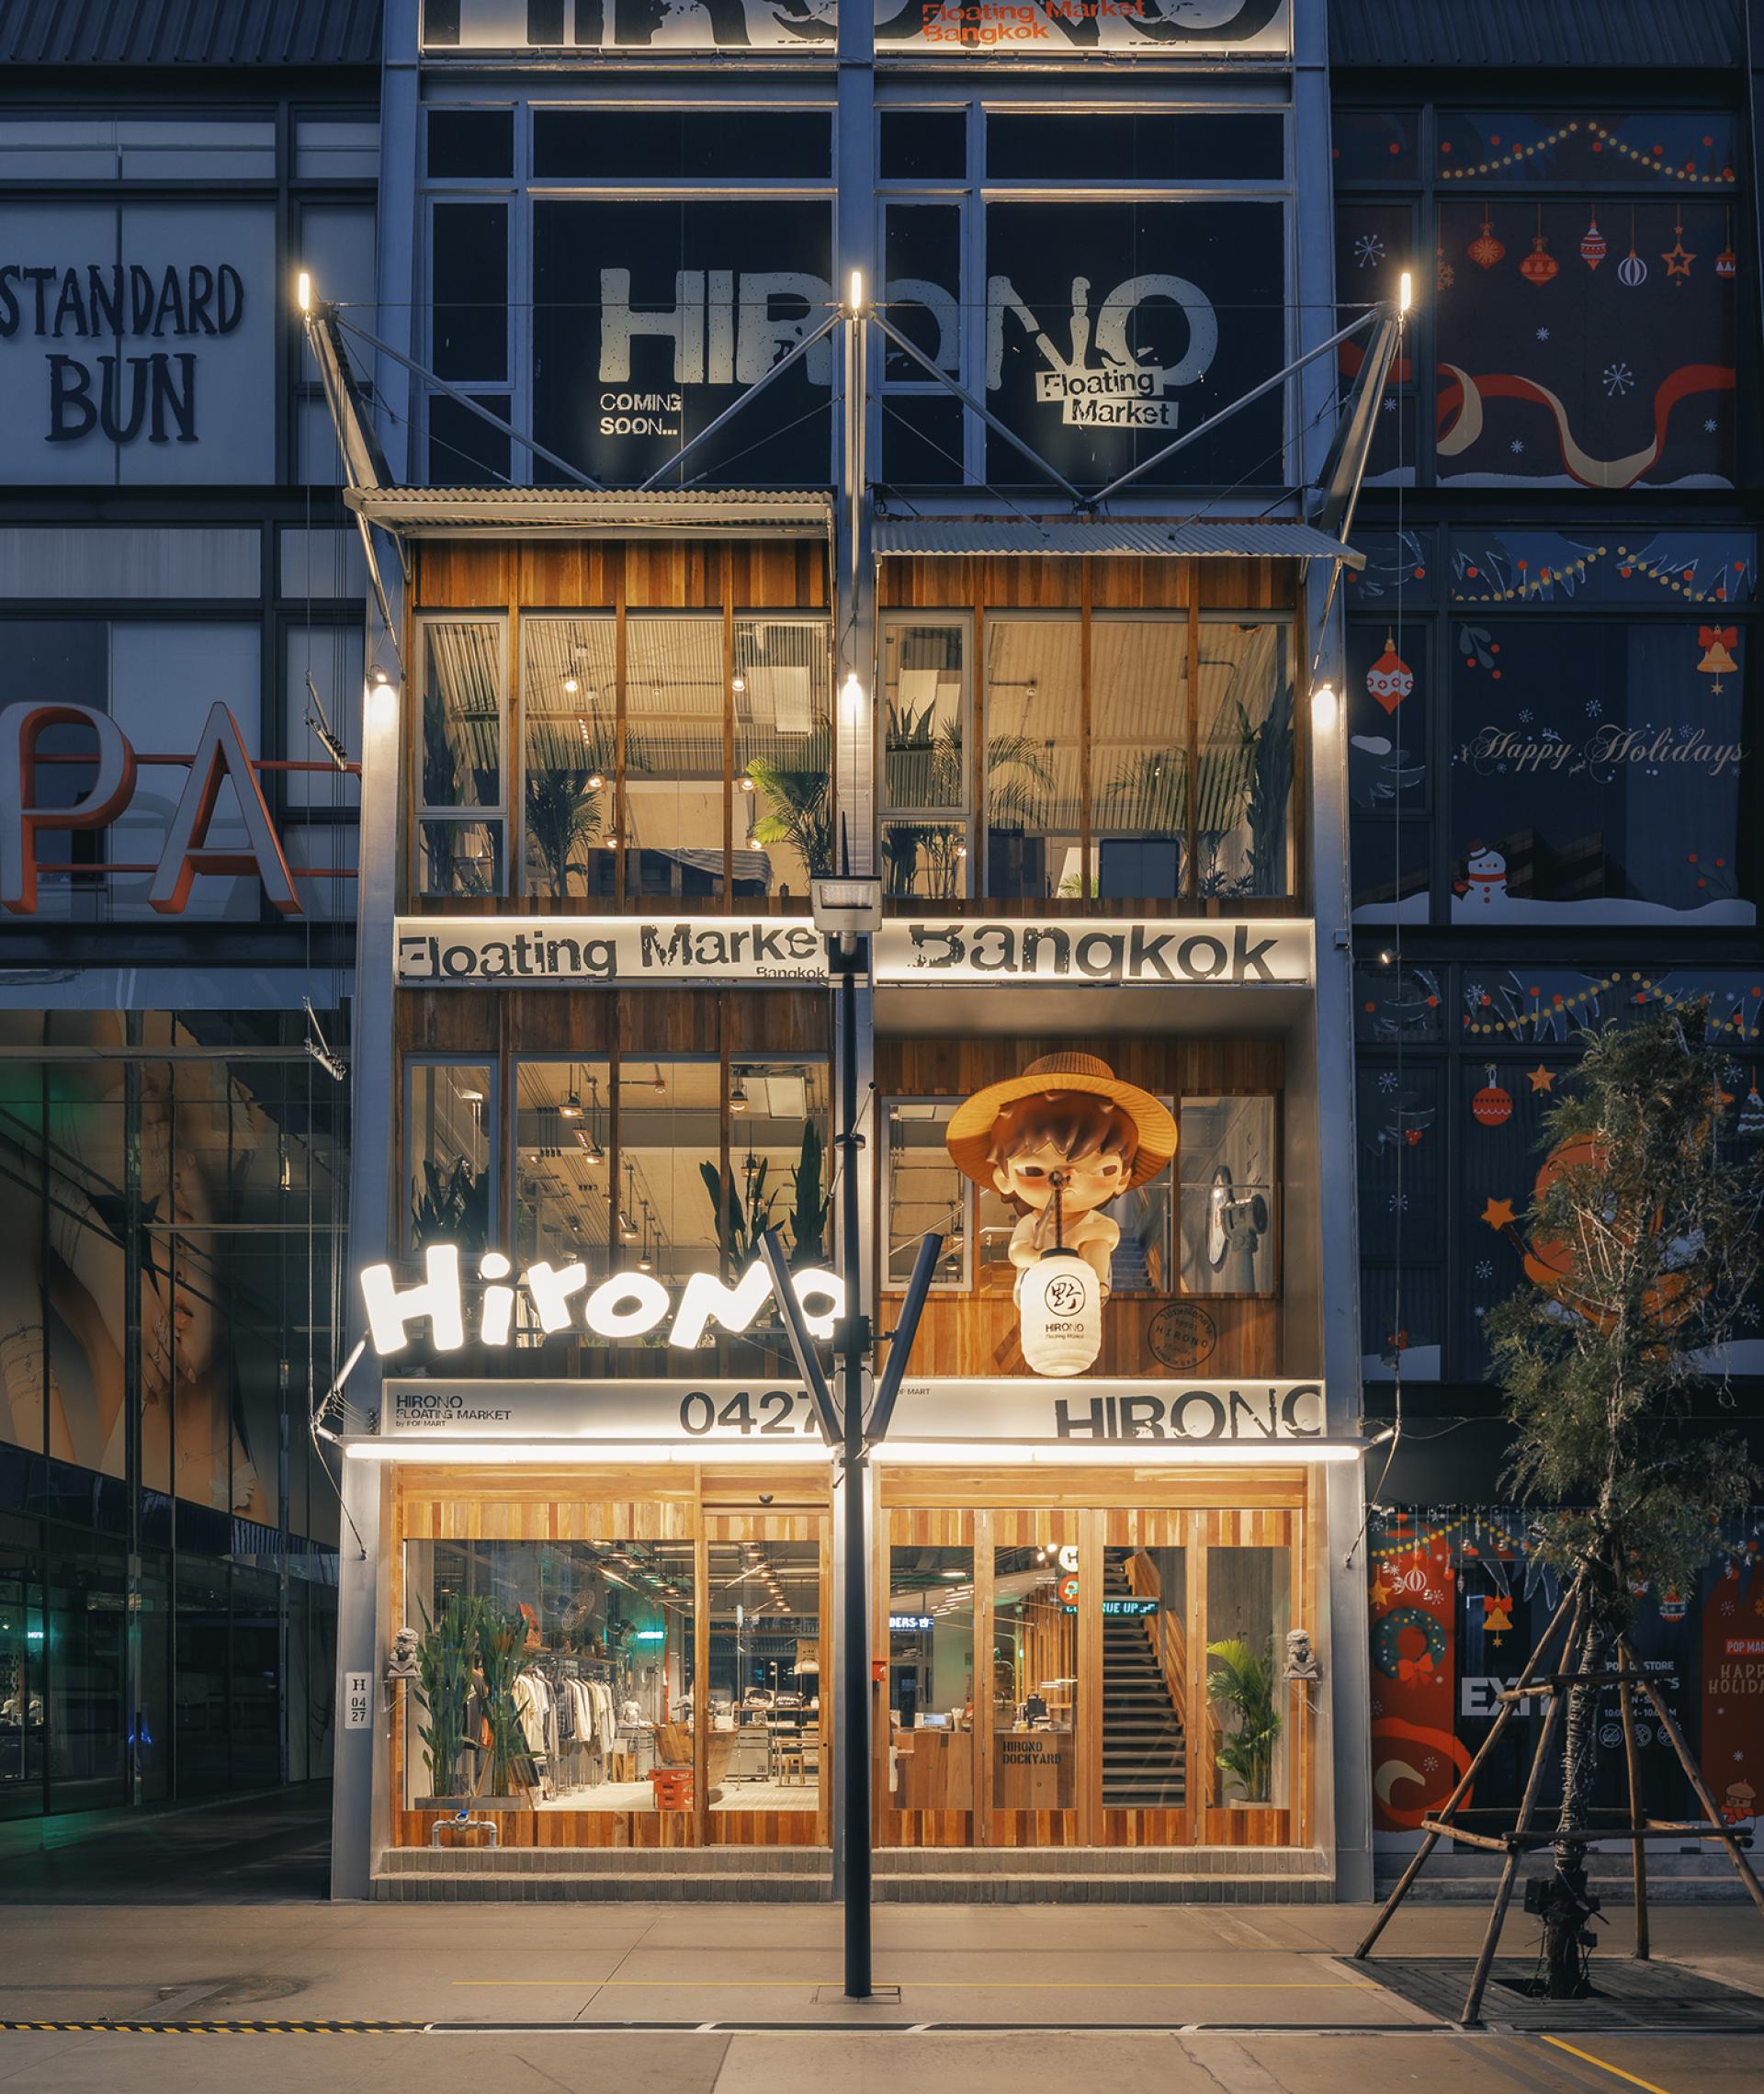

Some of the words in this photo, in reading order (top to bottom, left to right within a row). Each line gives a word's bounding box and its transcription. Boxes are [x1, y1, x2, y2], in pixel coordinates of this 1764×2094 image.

[922, 4, 1035, 22] Floating
[1046, 0, 1147, 18] Market
[922, 22, 1050, 44] Bangkok
[0, 264, 244, 338] STANDARD
[1044, 370, 1154, 398] Floating
[44, 352, 198, 443] BUN
[600, 393, 682, 412] COMING
[1071, 399, 1170, 425] Market
[600, 416, 678, 436] SOON...
[1470, 726, 1574, 775] Happy
[1584, 723, 1751, 784] Holidays
[399, 930, 617, 978] Floating
[640, 922, 830, 968] Marke
[906, 924, 1280, 979] Bangkok
[1045, 1323, 1085, 1332] HIRONO
[396, 1395, 463, 1409] HIRONO
[396, 1409, 454, 1420] FLOATING
[457, 1409, 512, 1421] MARKET
[1124, 1602, 1138, 1613] UP
[1727, 1641, 1745, 1652] POP
[1606, 1661, 1620, 1670] PO
[1644, 1660, 1675, 1670] STORE
[352, 1679, 367, 1692] H
[351, 1697, 367, 1707] 04
[351, 1711, 367, 1722] 27
[1003, 1741, 1043, 1752] HIRONO
[1003, 1753, 1063, 1765] DOCKYARD
